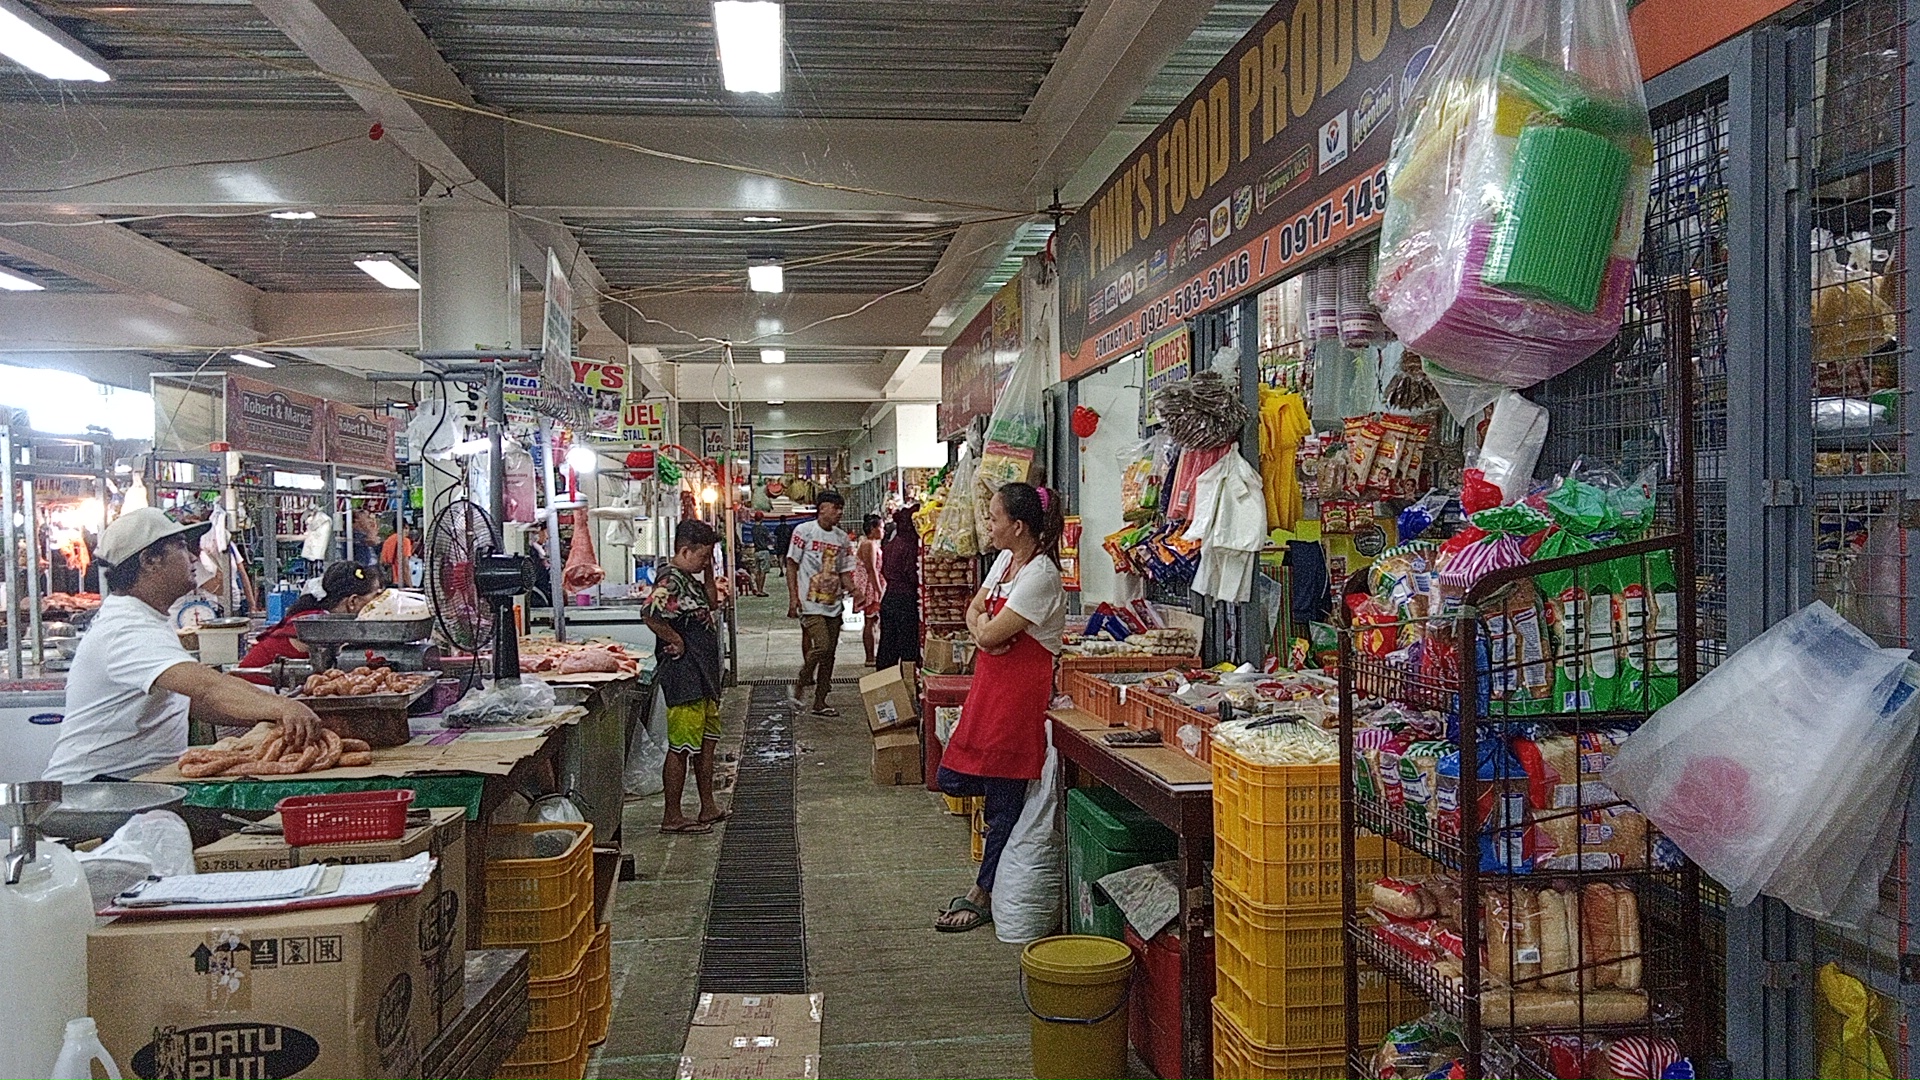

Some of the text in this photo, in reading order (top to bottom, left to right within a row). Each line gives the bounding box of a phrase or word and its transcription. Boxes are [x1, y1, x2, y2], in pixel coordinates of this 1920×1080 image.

[1156, 77, 1230, 227] FOOD
[1239, 0, 1432, 162] PROD
[1094, 325, 1123, 360] CONTACT
[1140, 250, 1250, 338] 0927-583-3146
[243, 396, 312, 430] Robert & Margie
[338, 416, 360, 436] Robert
[623, 430, 646, 441] STALL
[201, 859, 243, 871] 3.785L
[258, 942, 269, 954] 4
[189, 1027, 283, 1057] DATU
[189, 1056, 266, 1080] PUTI
